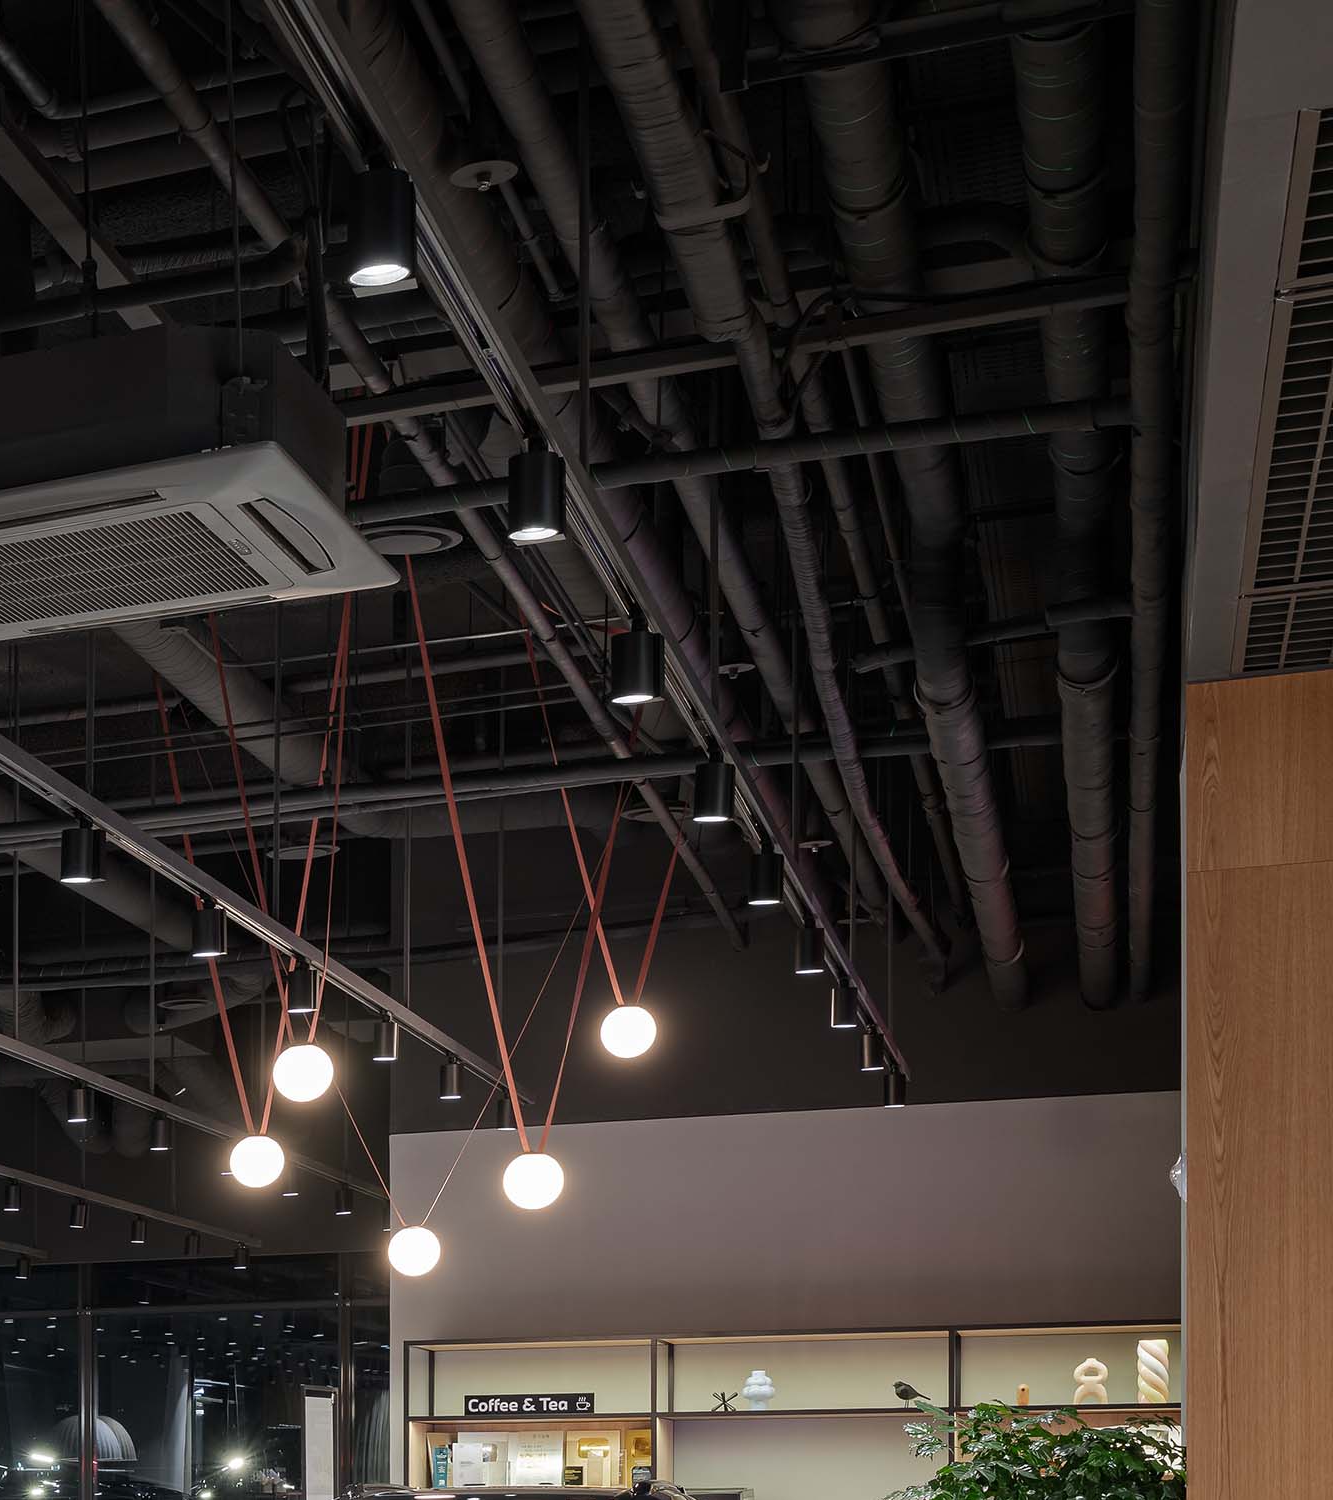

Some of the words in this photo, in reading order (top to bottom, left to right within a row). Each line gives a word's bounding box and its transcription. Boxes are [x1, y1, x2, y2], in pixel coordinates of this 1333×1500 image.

[468, 1399, 518, 1412] Coffee
[522, 1398, 536, 1411] &
[539, 1398, 568, 1411] Tea
